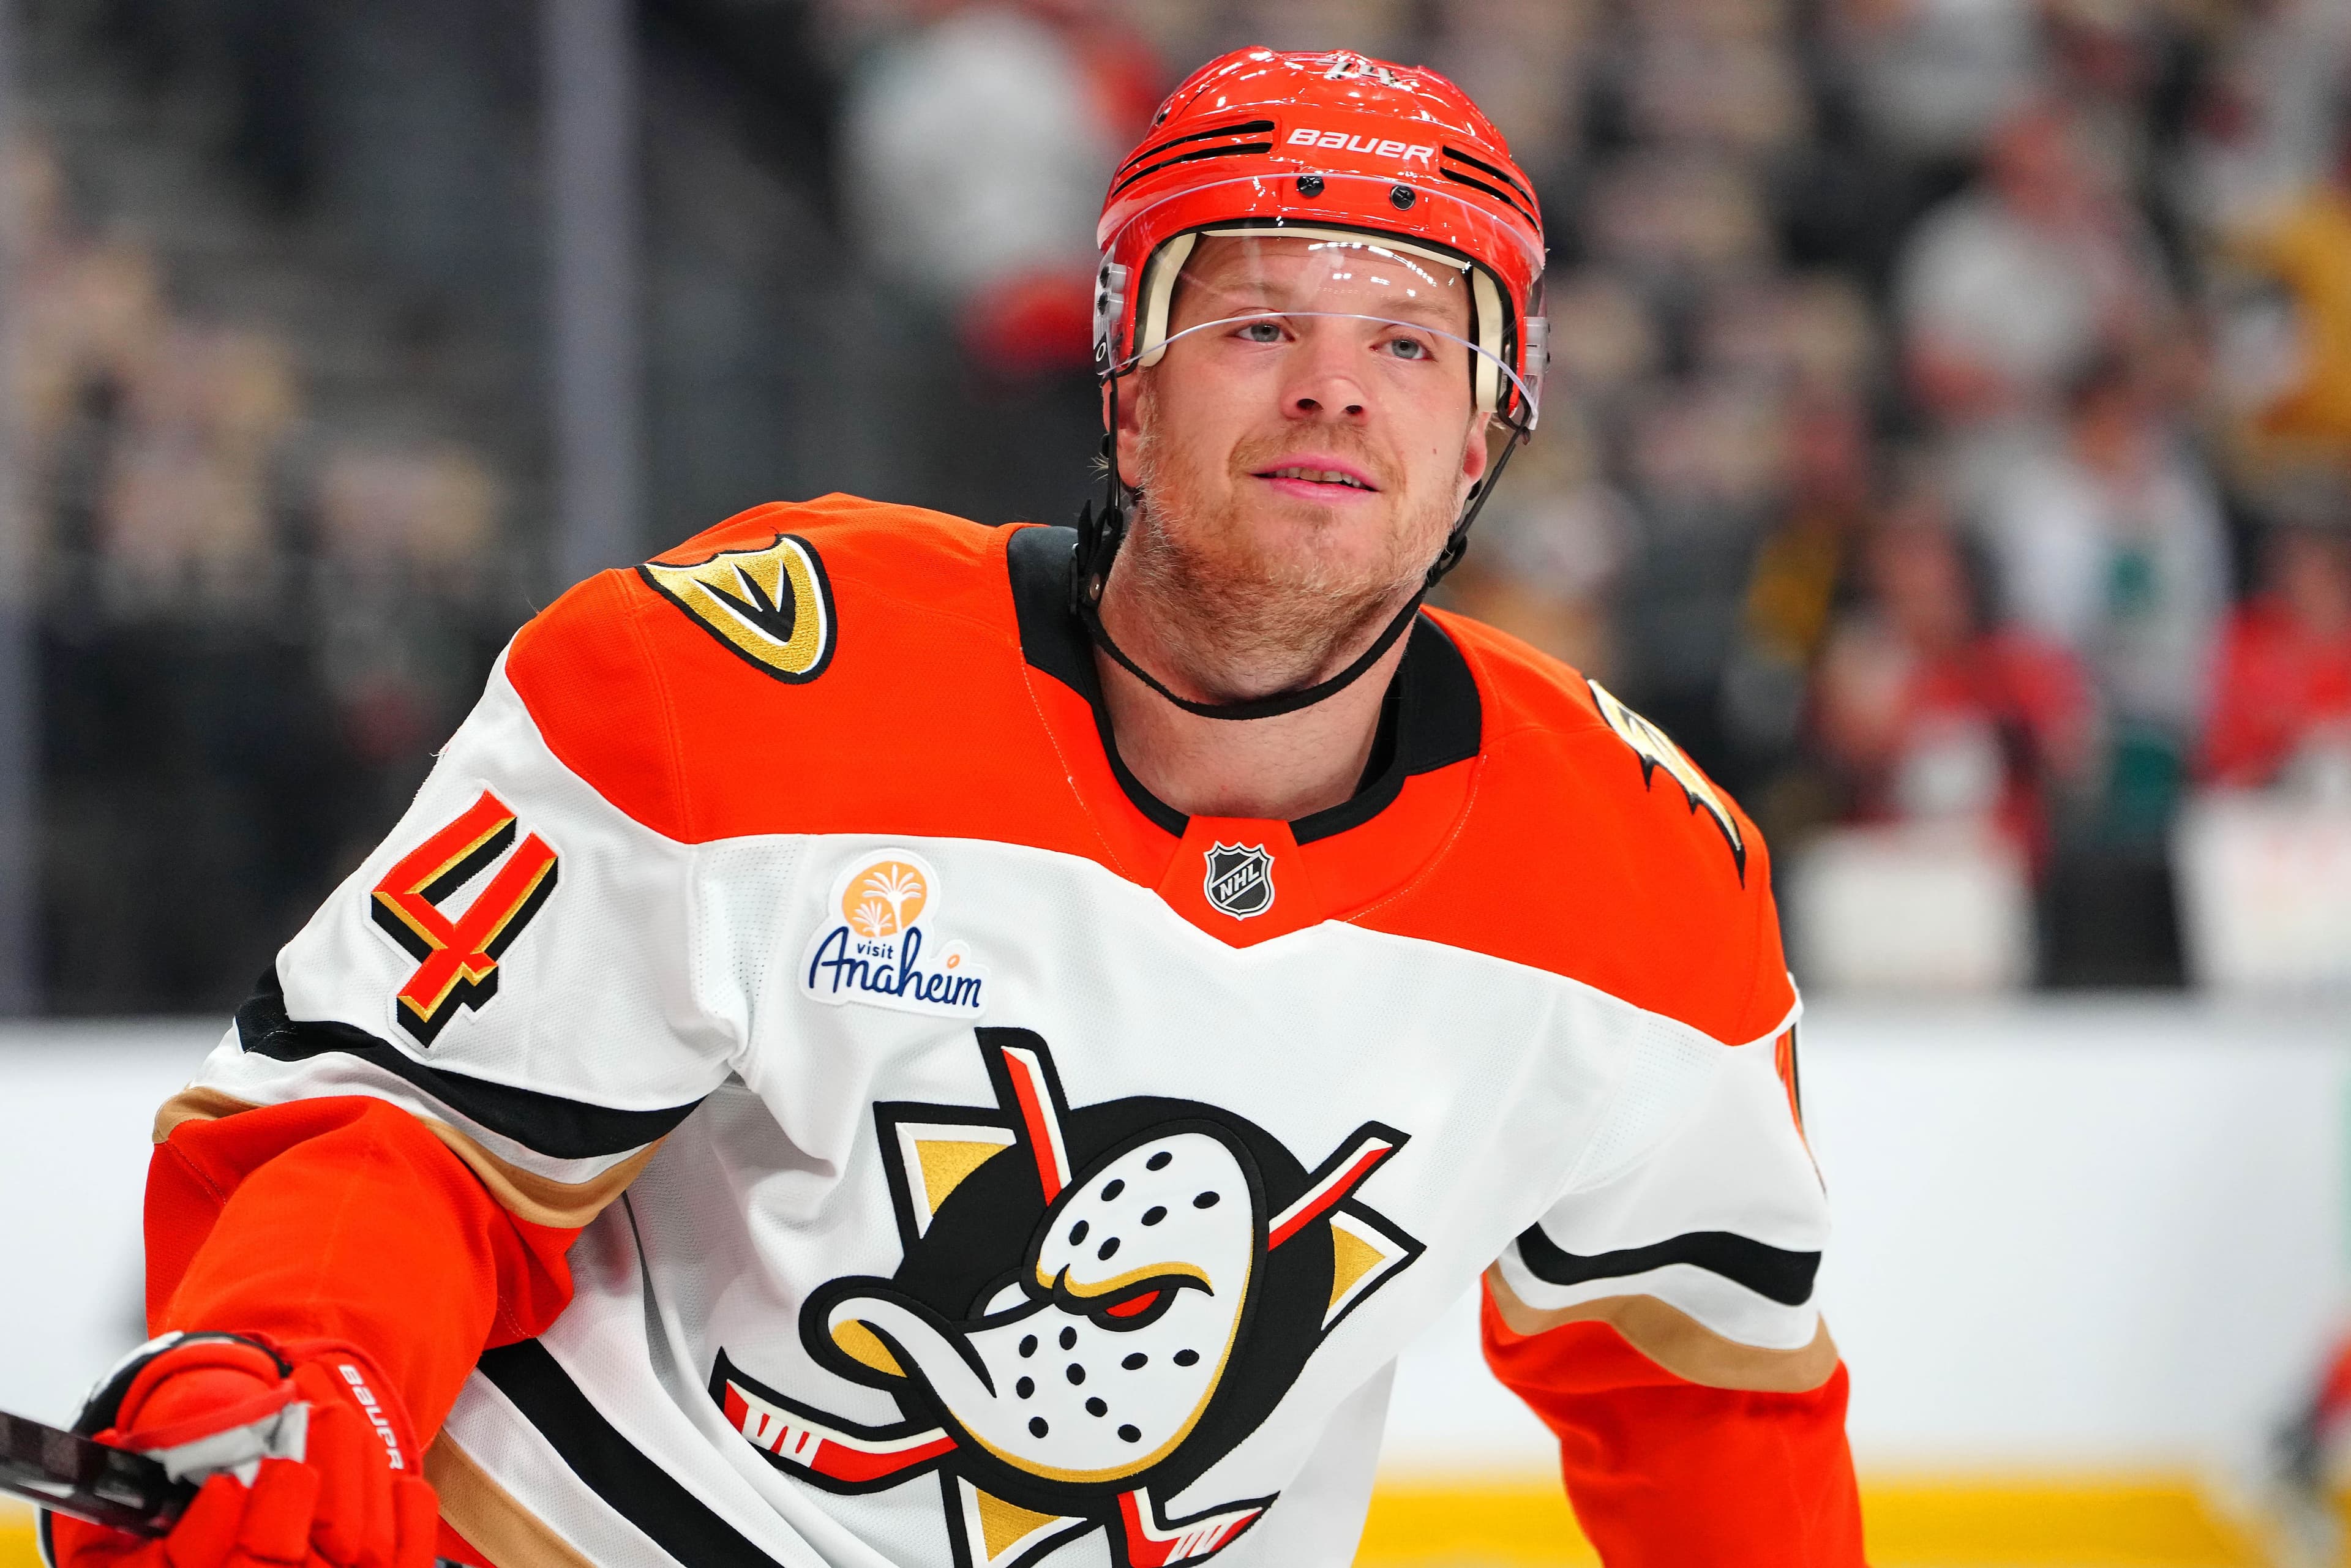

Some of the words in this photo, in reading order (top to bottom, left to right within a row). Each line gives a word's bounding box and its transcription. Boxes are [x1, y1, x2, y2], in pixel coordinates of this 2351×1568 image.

[1220, 863, 1259, 901] NHL
[809, 926, 981, 1008] Anaheim
[857, 940, 893, 959] visit
